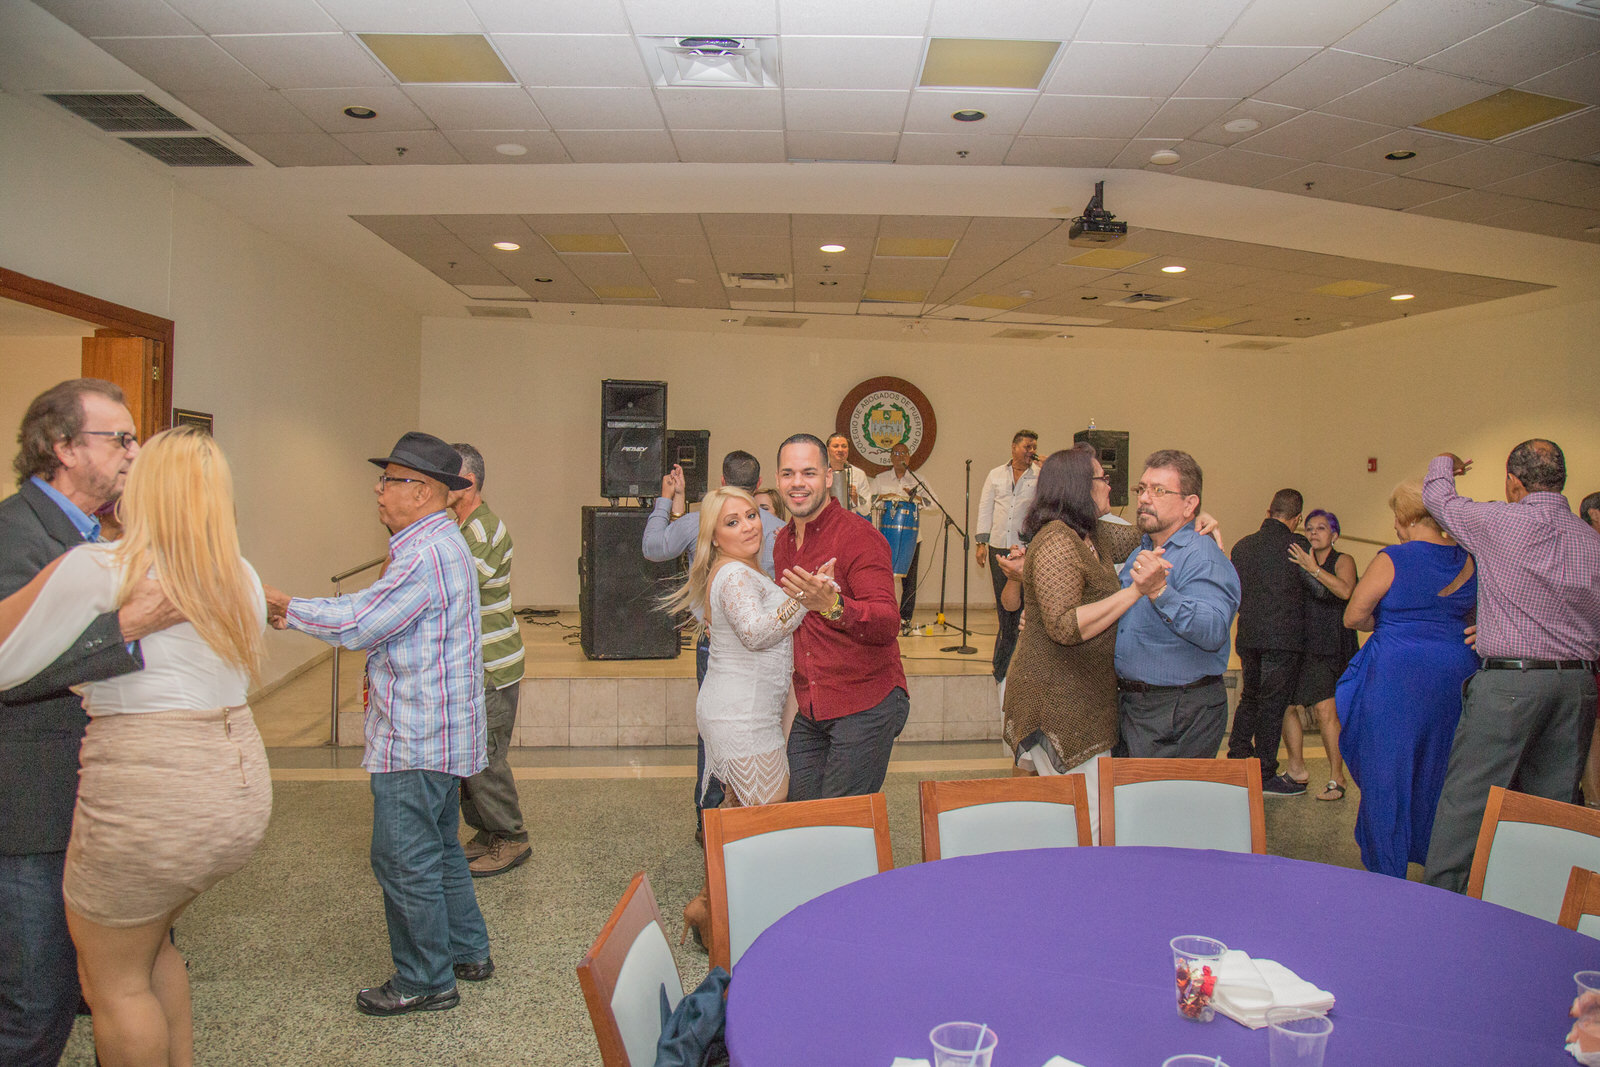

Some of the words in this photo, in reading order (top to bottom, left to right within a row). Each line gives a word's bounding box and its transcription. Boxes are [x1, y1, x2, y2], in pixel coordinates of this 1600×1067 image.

[861, 392, 900, 408] ABOGADOS
[900, 396, 911, 407] DE
[854, 407, 863, 421] DE
[910, 407, 922, 437] PUERTO
[852, 421, 867, 454] COLEGIO
